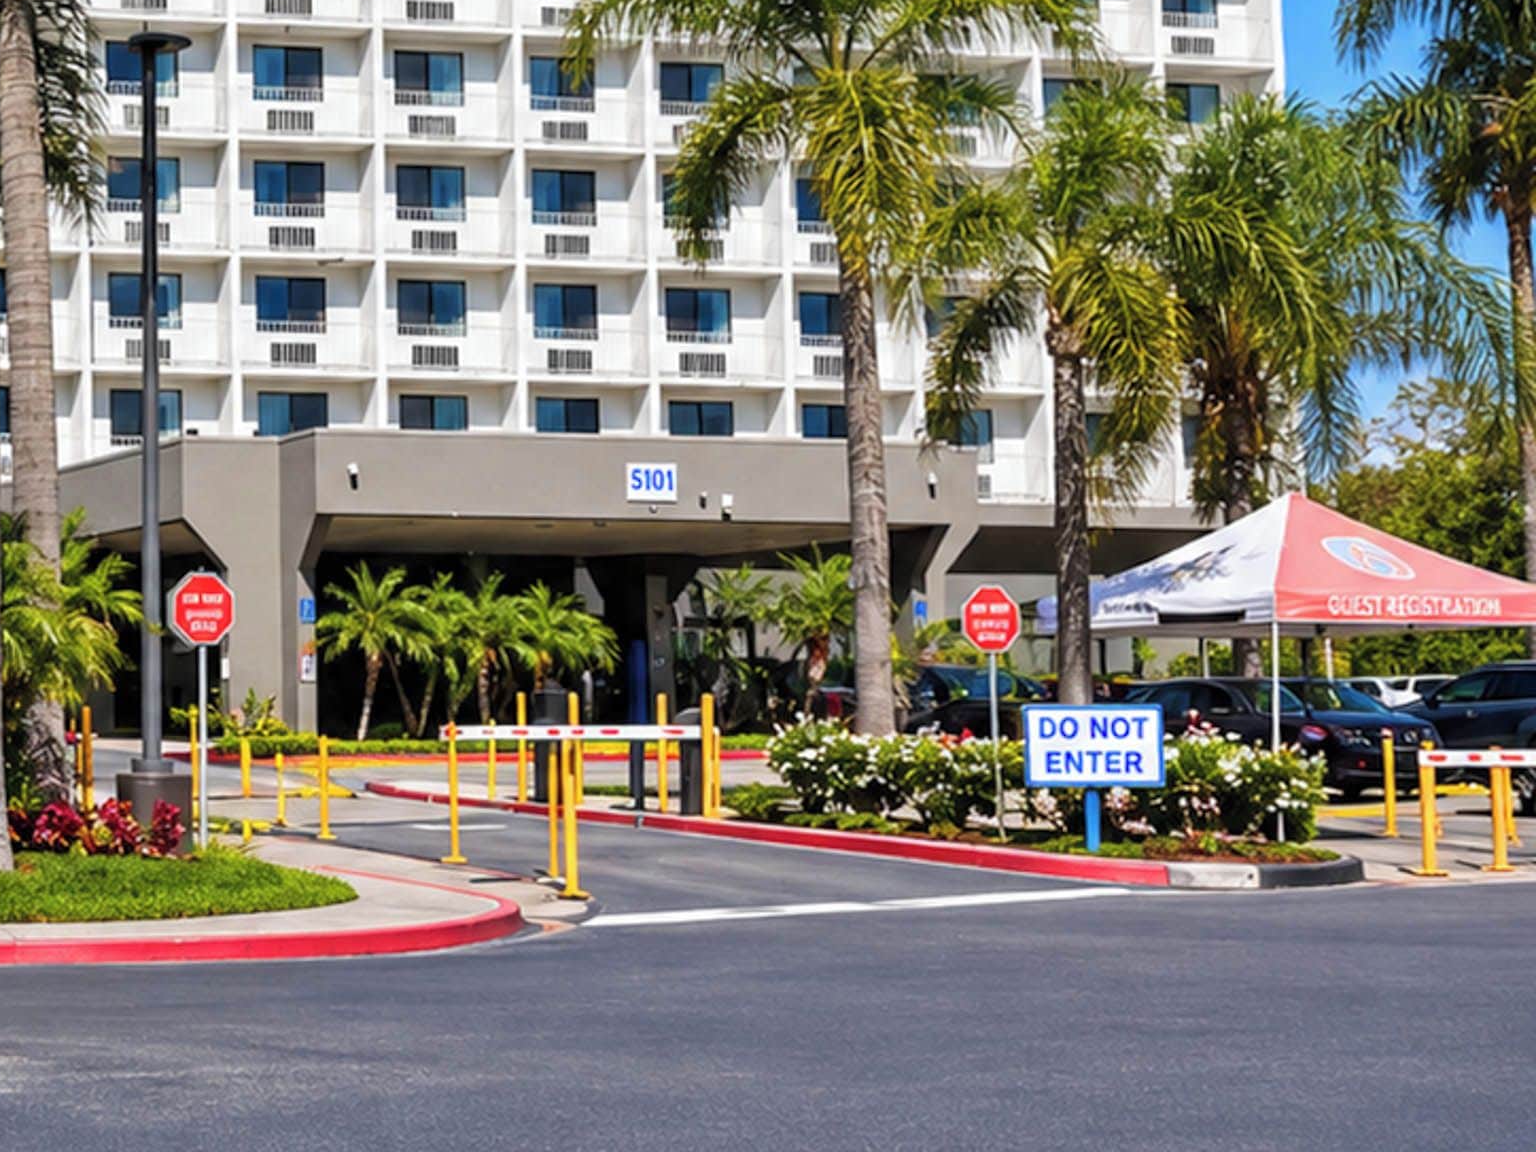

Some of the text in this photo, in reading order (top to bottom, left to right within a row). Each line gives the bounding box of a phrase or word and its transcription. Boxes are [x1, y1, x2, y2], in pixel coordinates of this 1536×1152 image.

[1039, 716, 1149, 740] DO NOT
[1045, 750, 1144, 775] ENTER
